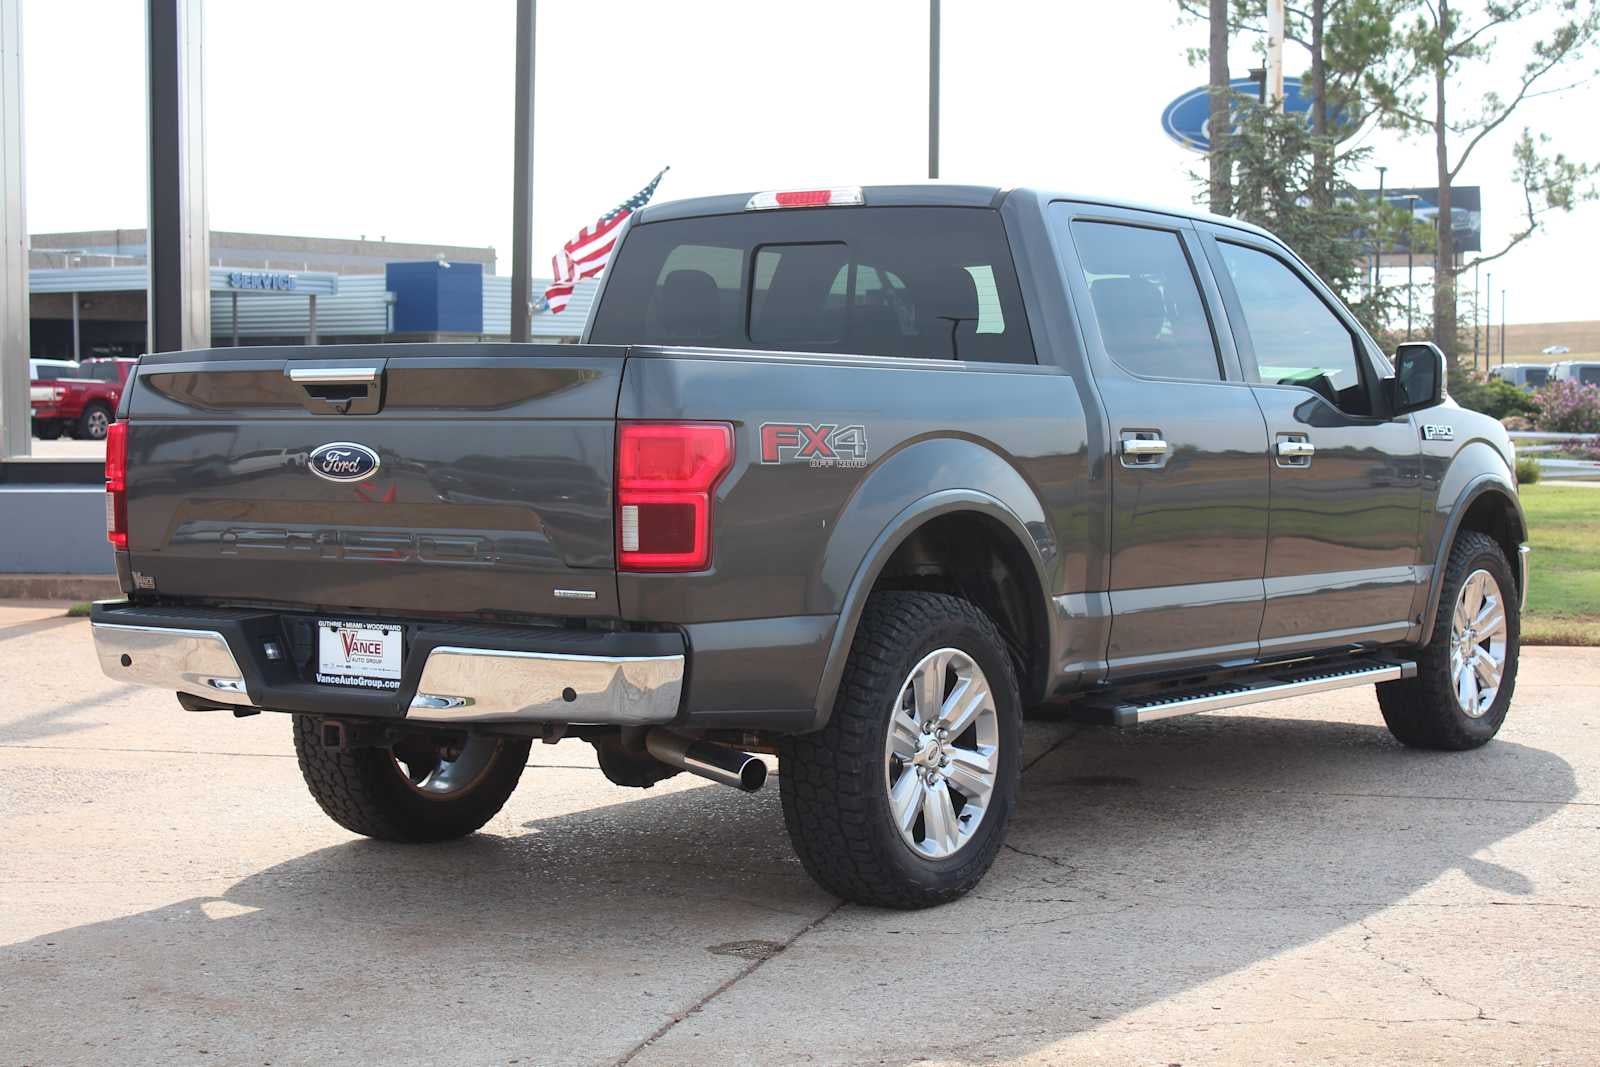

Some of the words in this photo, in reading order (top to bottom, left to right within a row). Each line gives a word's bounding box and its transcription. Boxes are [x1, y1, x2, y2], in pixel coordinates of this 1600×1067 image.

[226, 272, 297, 289] SERVICE
[759, 422, 867, 464] FX4
[323, 450, 360, 472] Ford
[809, 459, 833, 468] OFF
[318, 620, 342, 628] GUTHRIE
[366, 623, 401, 632] WOODWARD
[339, 629, 382, 662] VANCE
